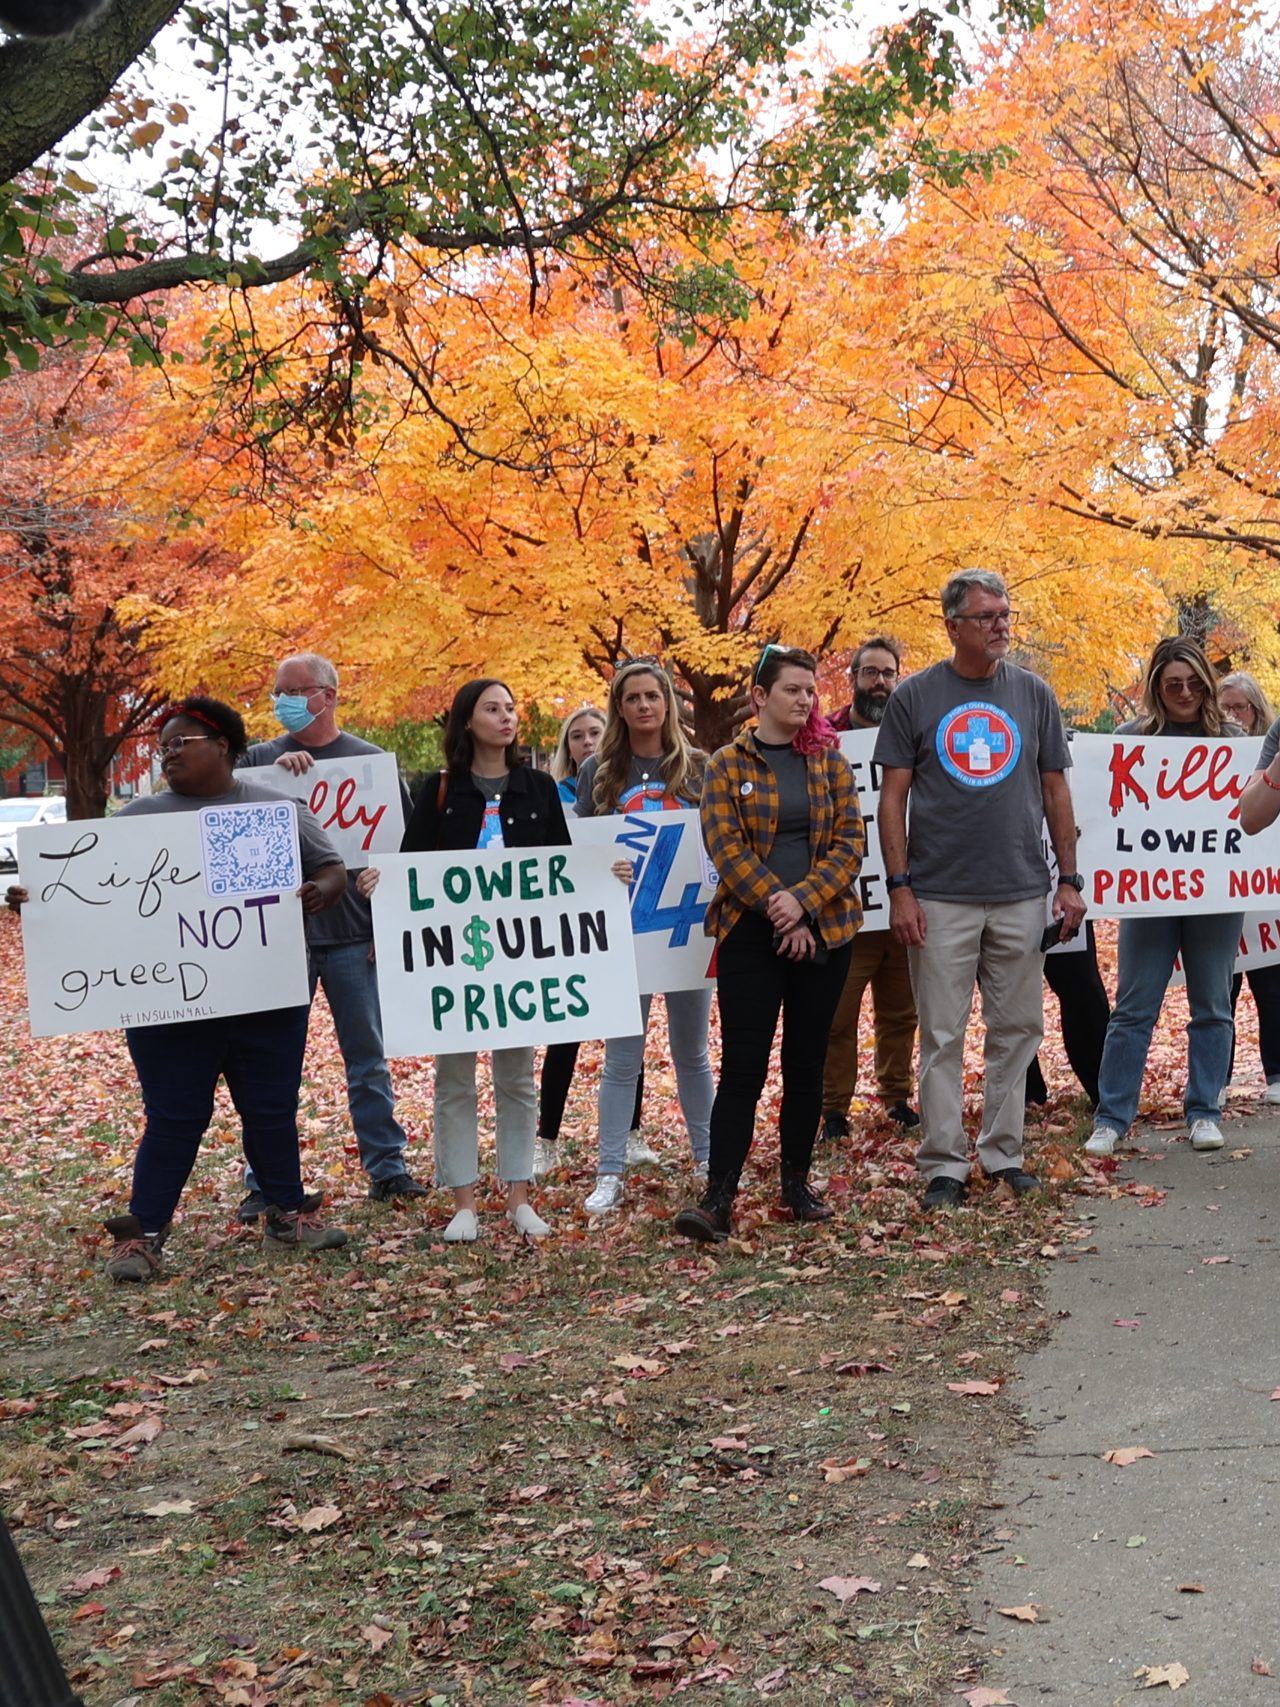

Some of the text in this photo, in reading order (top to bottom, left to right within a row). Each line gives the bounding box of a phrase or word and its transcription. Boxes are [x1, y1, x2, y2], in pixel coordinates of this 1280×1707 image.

[1108, 743, 1252, 820] Killy
[1116, 828, 1242, 854] LOWER
[39, 832, 201, 917] Life
[408, 854, 575, 911] LOWER
[631, 823, 710, 948] 4
[1093, 868, 1205, 905] PRICES
[178, 894, 280, 950] NOT
[402, 910, 609, 972] IN$ULIN
[431, 974, 590, 1032] PRICES
